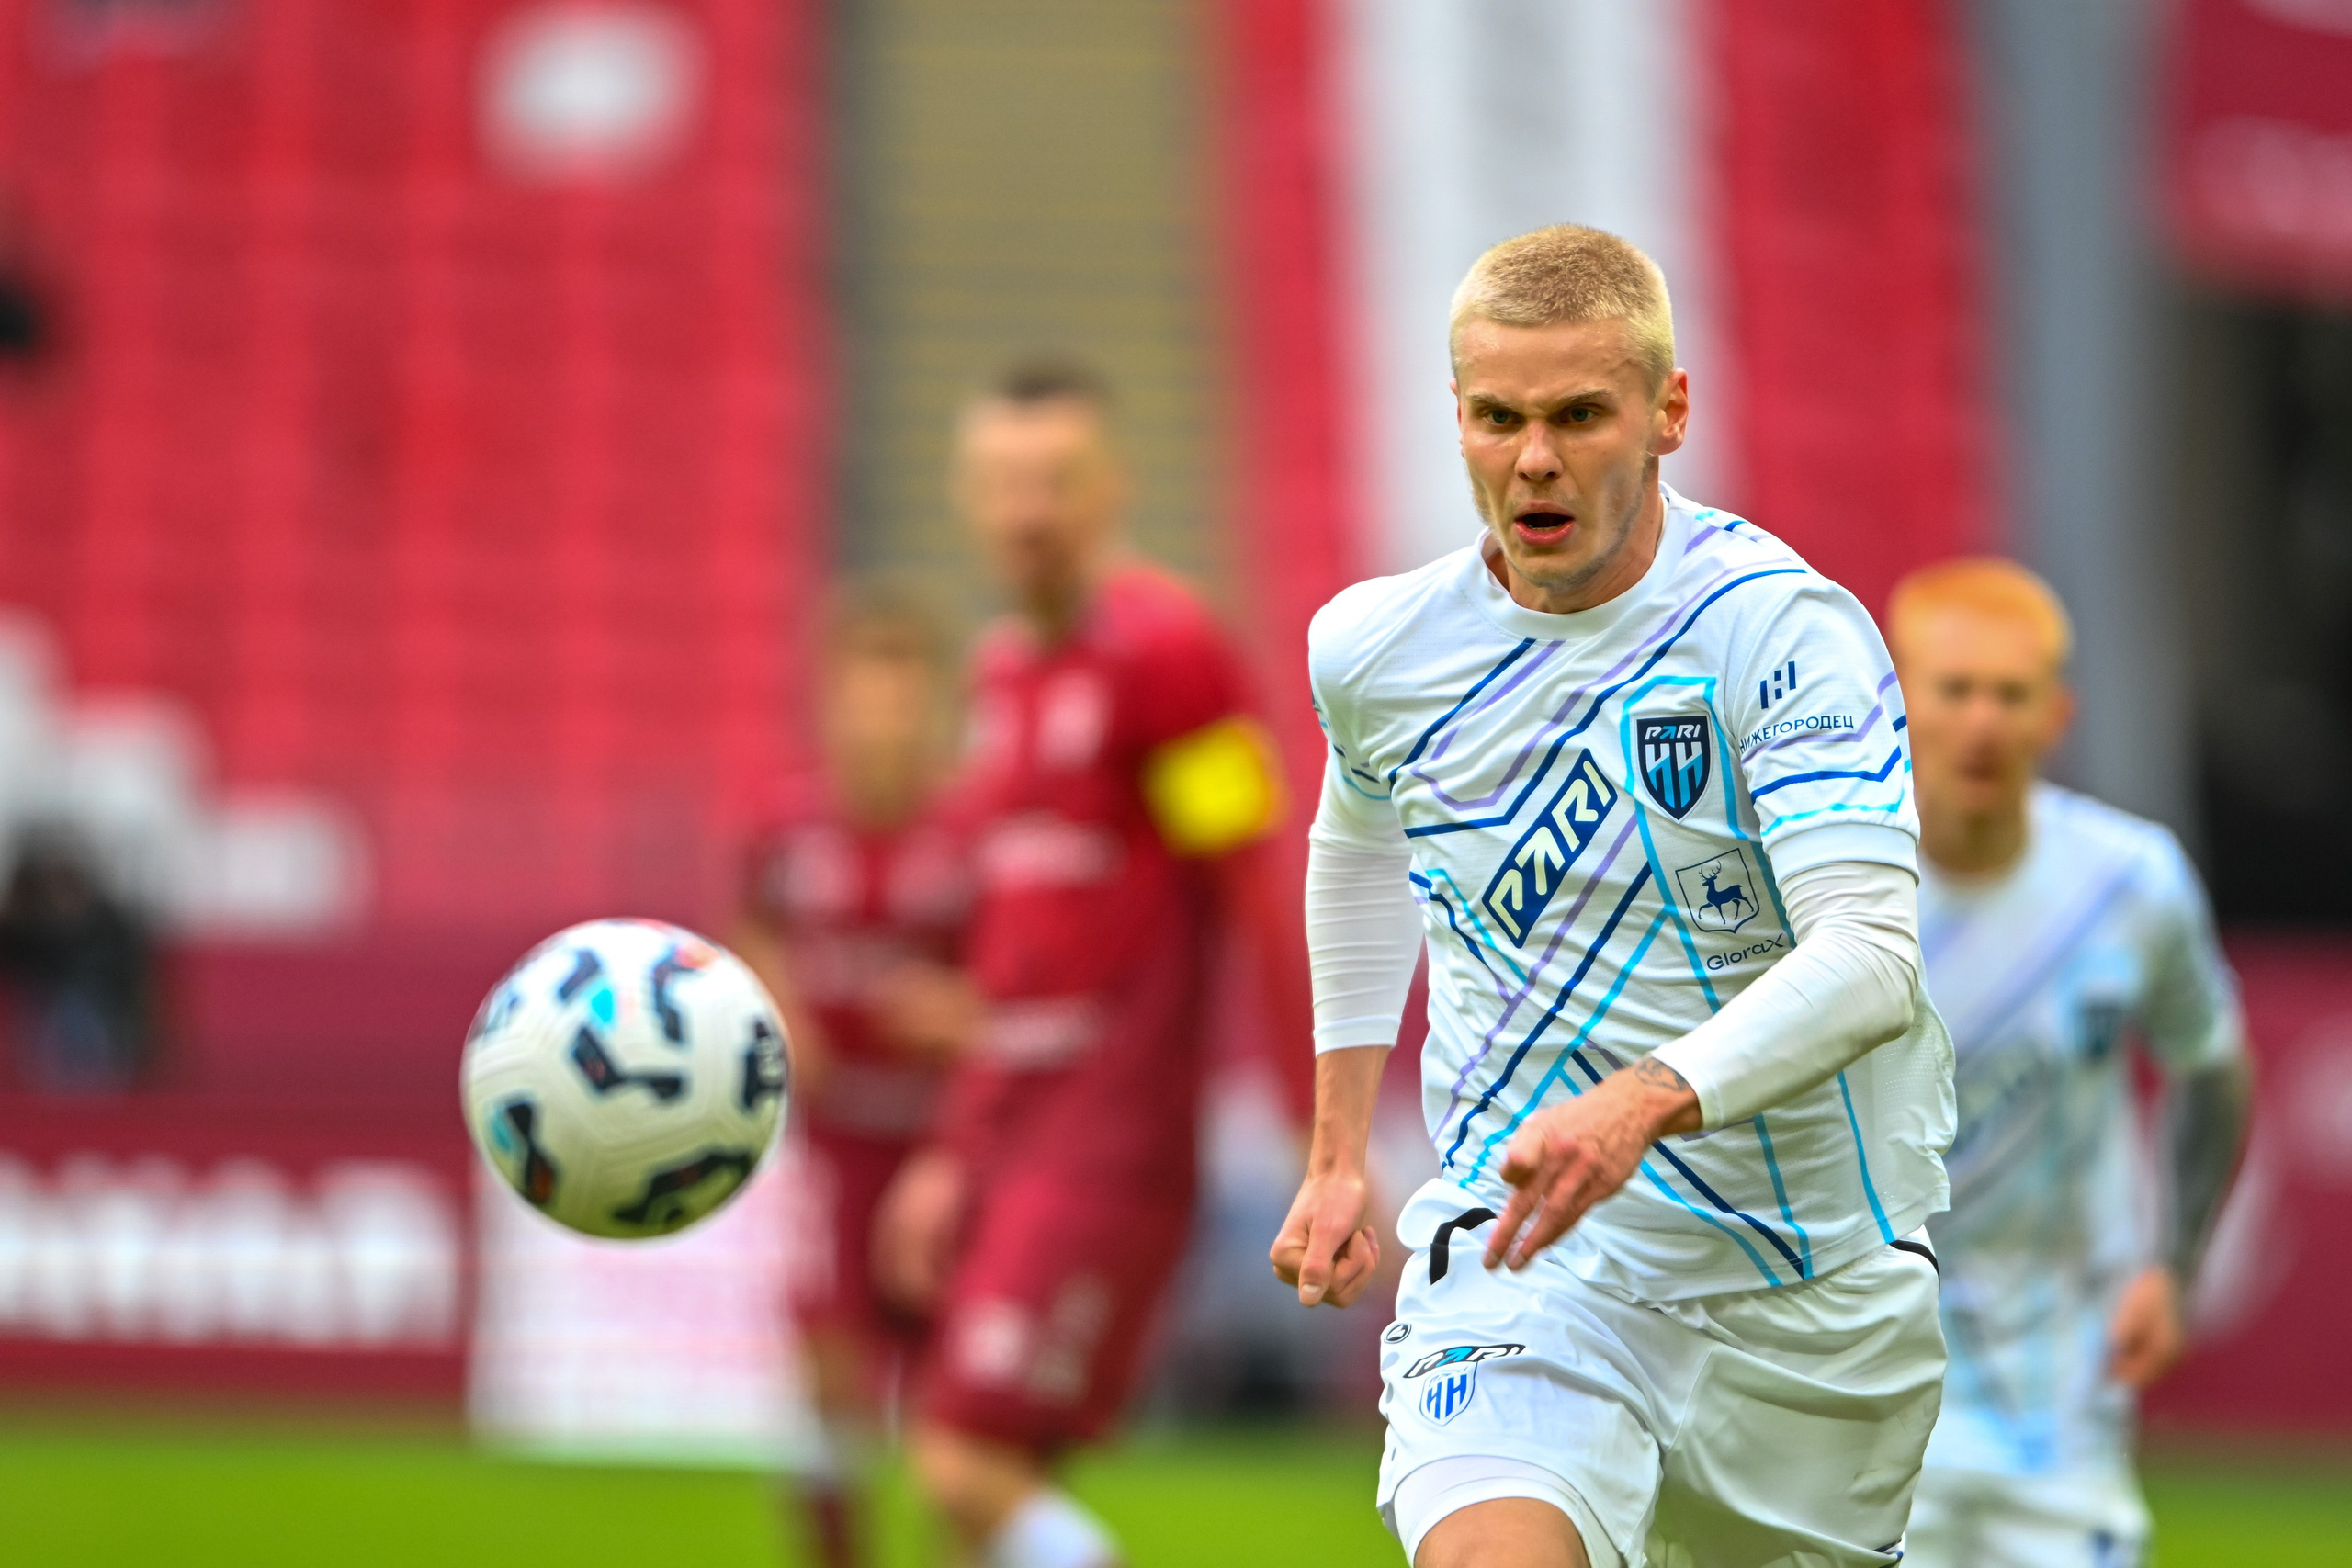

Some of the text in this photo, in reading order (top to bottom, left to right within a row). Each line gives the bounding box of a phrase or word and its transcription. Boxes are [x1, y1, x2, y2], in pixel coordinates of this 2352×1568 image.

[1645, 724, 1701, 740] PARI
[1739, 715, 1854, 754] НИЖЕГОРОДЕЦ
[1488, 761, 1611, 940] PARI
[1706, 932, 1784, 971] GloraX
